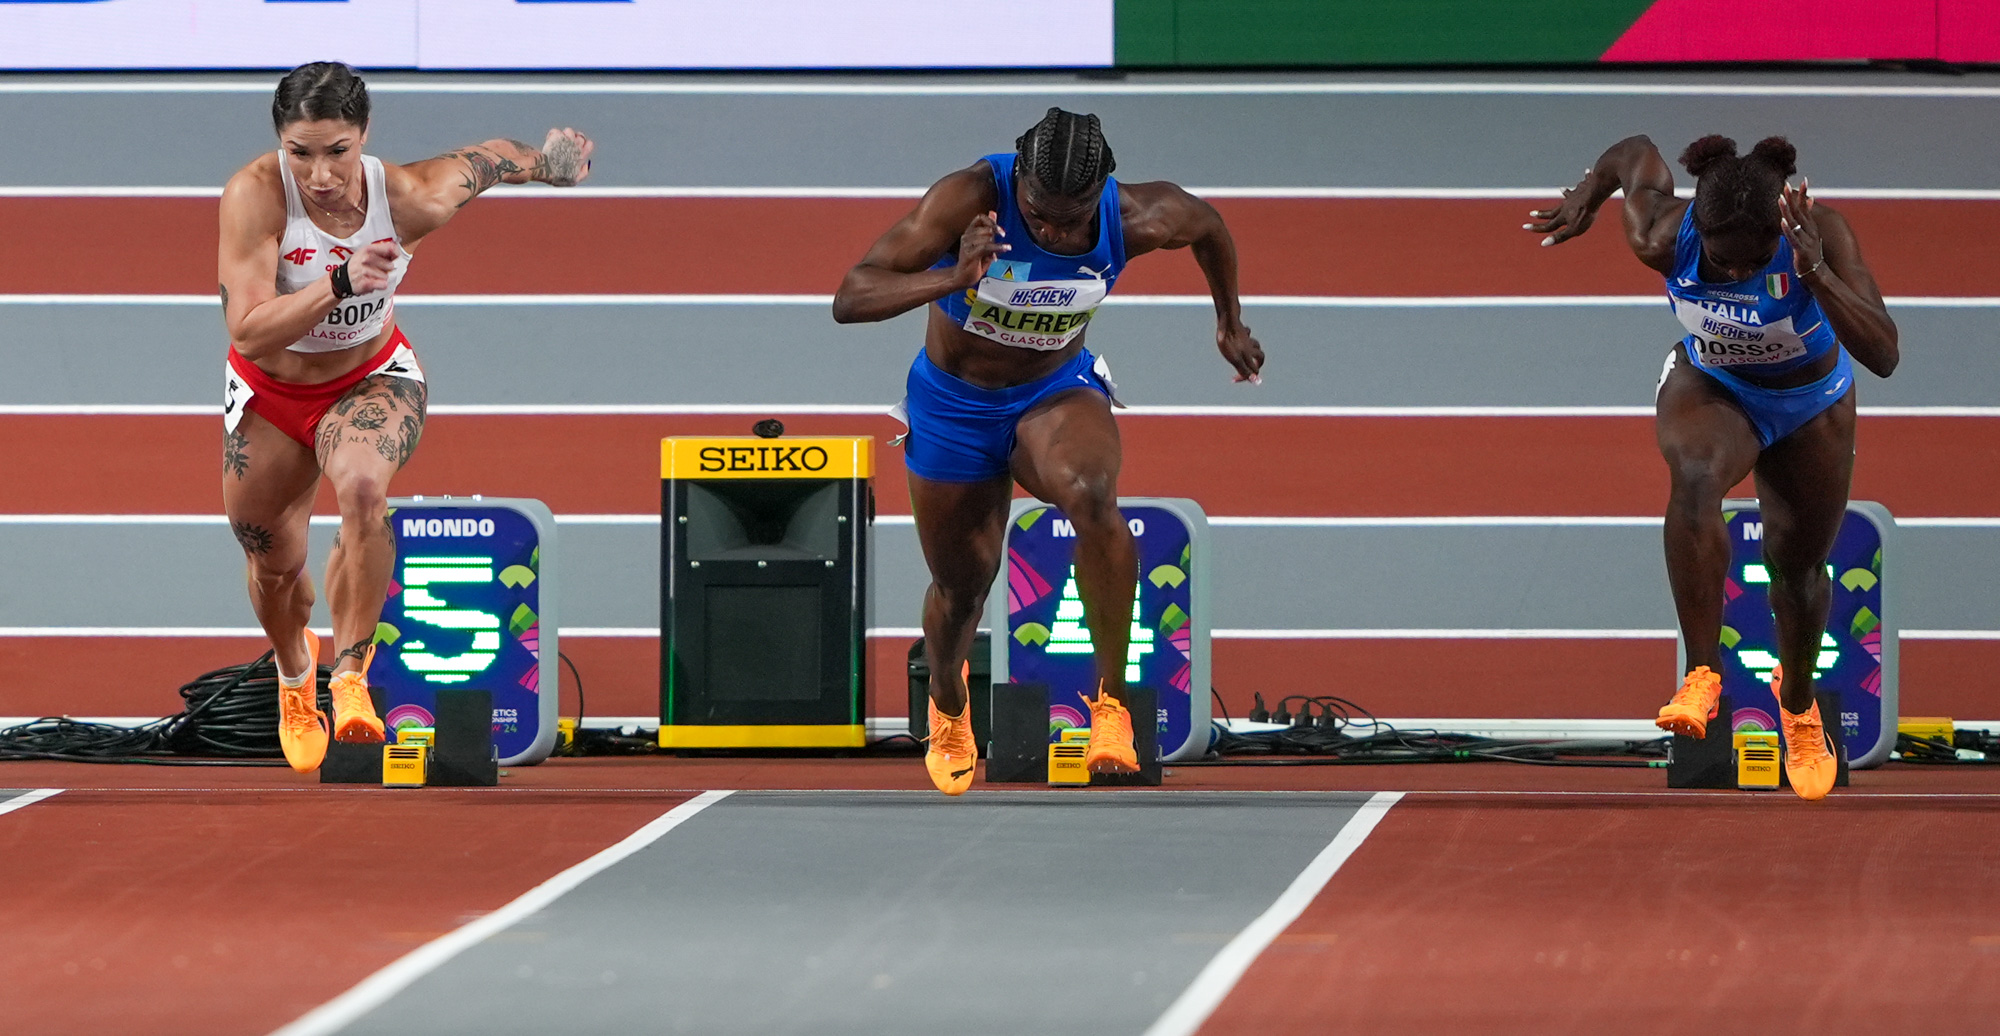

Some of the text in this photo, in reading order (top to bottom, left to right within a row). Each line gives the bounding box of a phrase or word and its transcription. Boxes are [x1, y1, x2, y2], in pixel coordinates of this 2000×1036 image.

[283, 247, 317, 266] 4F
[1008, 287, 1076, 307] HI-CHEW
[319, 297, 384, 326] BODA
[1701, 316, 1765, 342] HI-CHEW
[699, 446, 828, 472] SEIKO
[402, 518, 495, 537] MONDO
[400, 556, 501, 684] 5
[492, 708, 518, 717] ETICS
